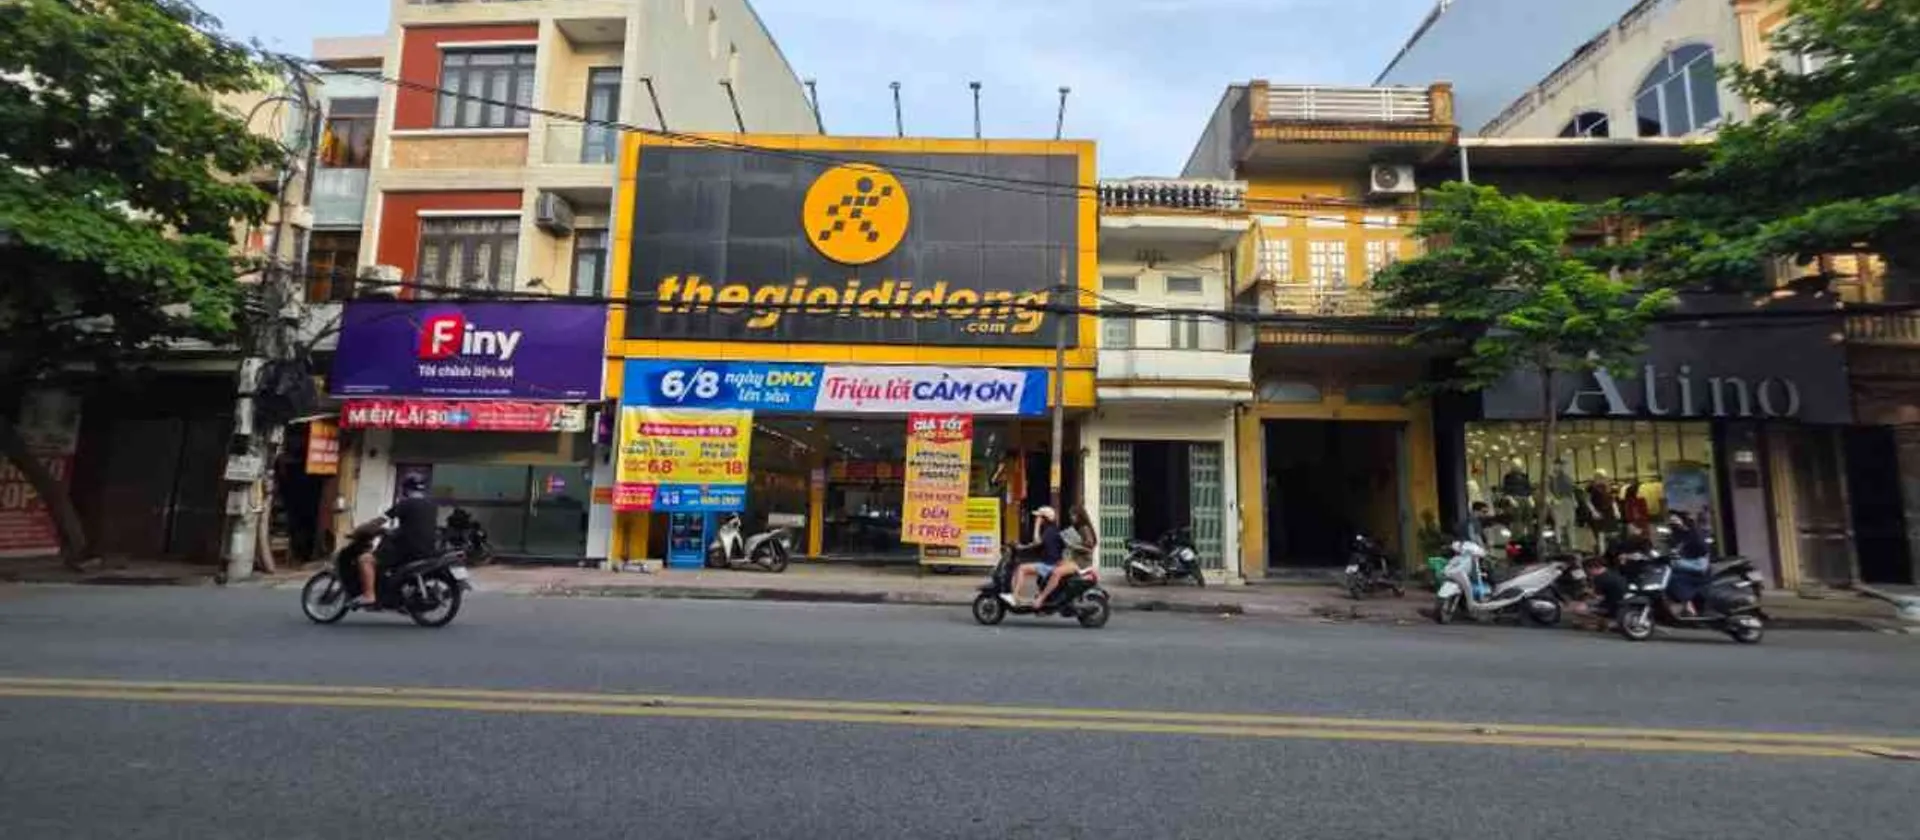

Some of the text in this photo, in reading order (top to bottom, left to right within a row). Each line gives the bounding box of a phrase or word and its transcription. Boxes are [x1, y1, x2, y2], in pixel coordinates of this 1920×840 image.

[656, 274, 1049, 334] thegioididong
[432, 320, 522, 360] Finy
[960, 321, 1005, 334] .com
[661, 367, 719, 402] 6/8
[724, 370, 764, 387] ngày
[827, 376, 880, 406] Triệu
[913, 373, 973, 401] CẢM
[976, 381, 1017, 401] ƠN
[1564, 350, 1800, 416] Atino
